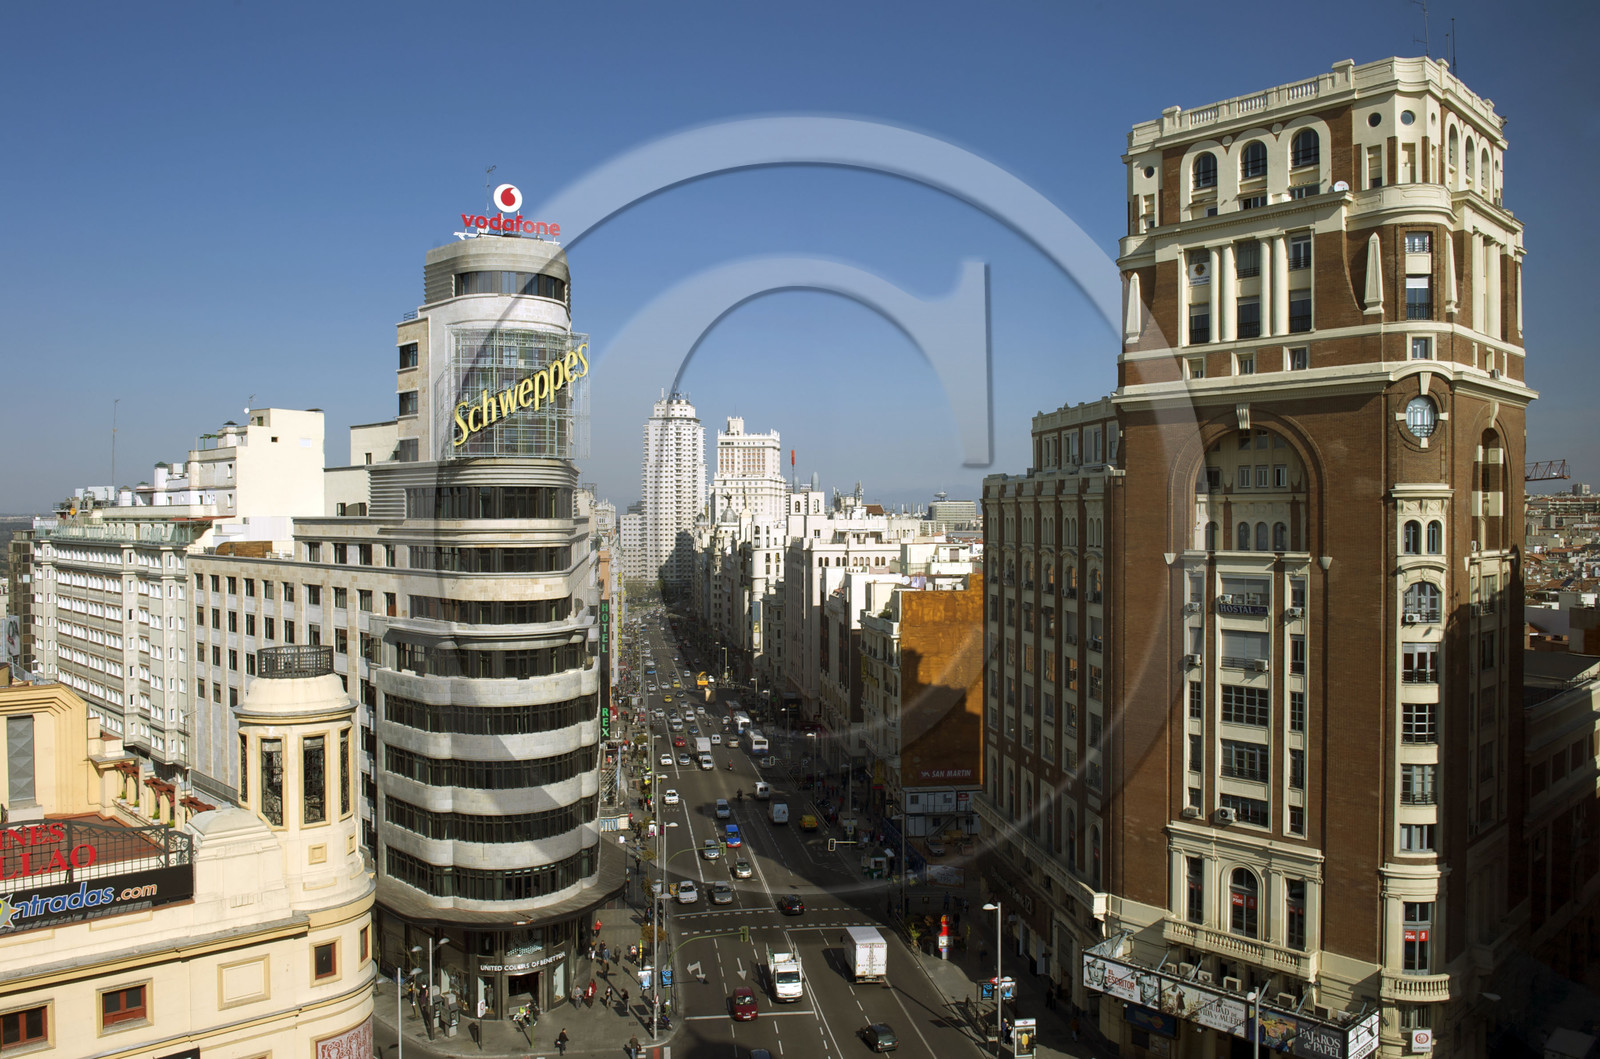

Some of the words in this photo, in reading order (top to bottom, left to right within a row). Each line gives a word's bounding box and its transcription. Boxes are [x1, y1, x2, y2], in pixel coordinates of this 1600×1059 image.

[461, 213, 561, 236] vodafone
[454, 343, 589, 447] Schweppes
[1219, 604, 1254, 614] HOSTAL
[601, 604, 609, 653] HOTEL
[601, 707, 610, 737] REX
[931, 769, 945, 778] SAN
[946, 769, 972, 777] MARTIN
[0, 843, 96, 880] LLAO
[480, 964, 503, 972] UNITED
[531, 960, 540, 968] OF
[540, 951, 566, 966] BENETTON
[1107, 975, 1135, 991] ESCRITOR
[1313, 1041, 1343, 1059] PAPEL
